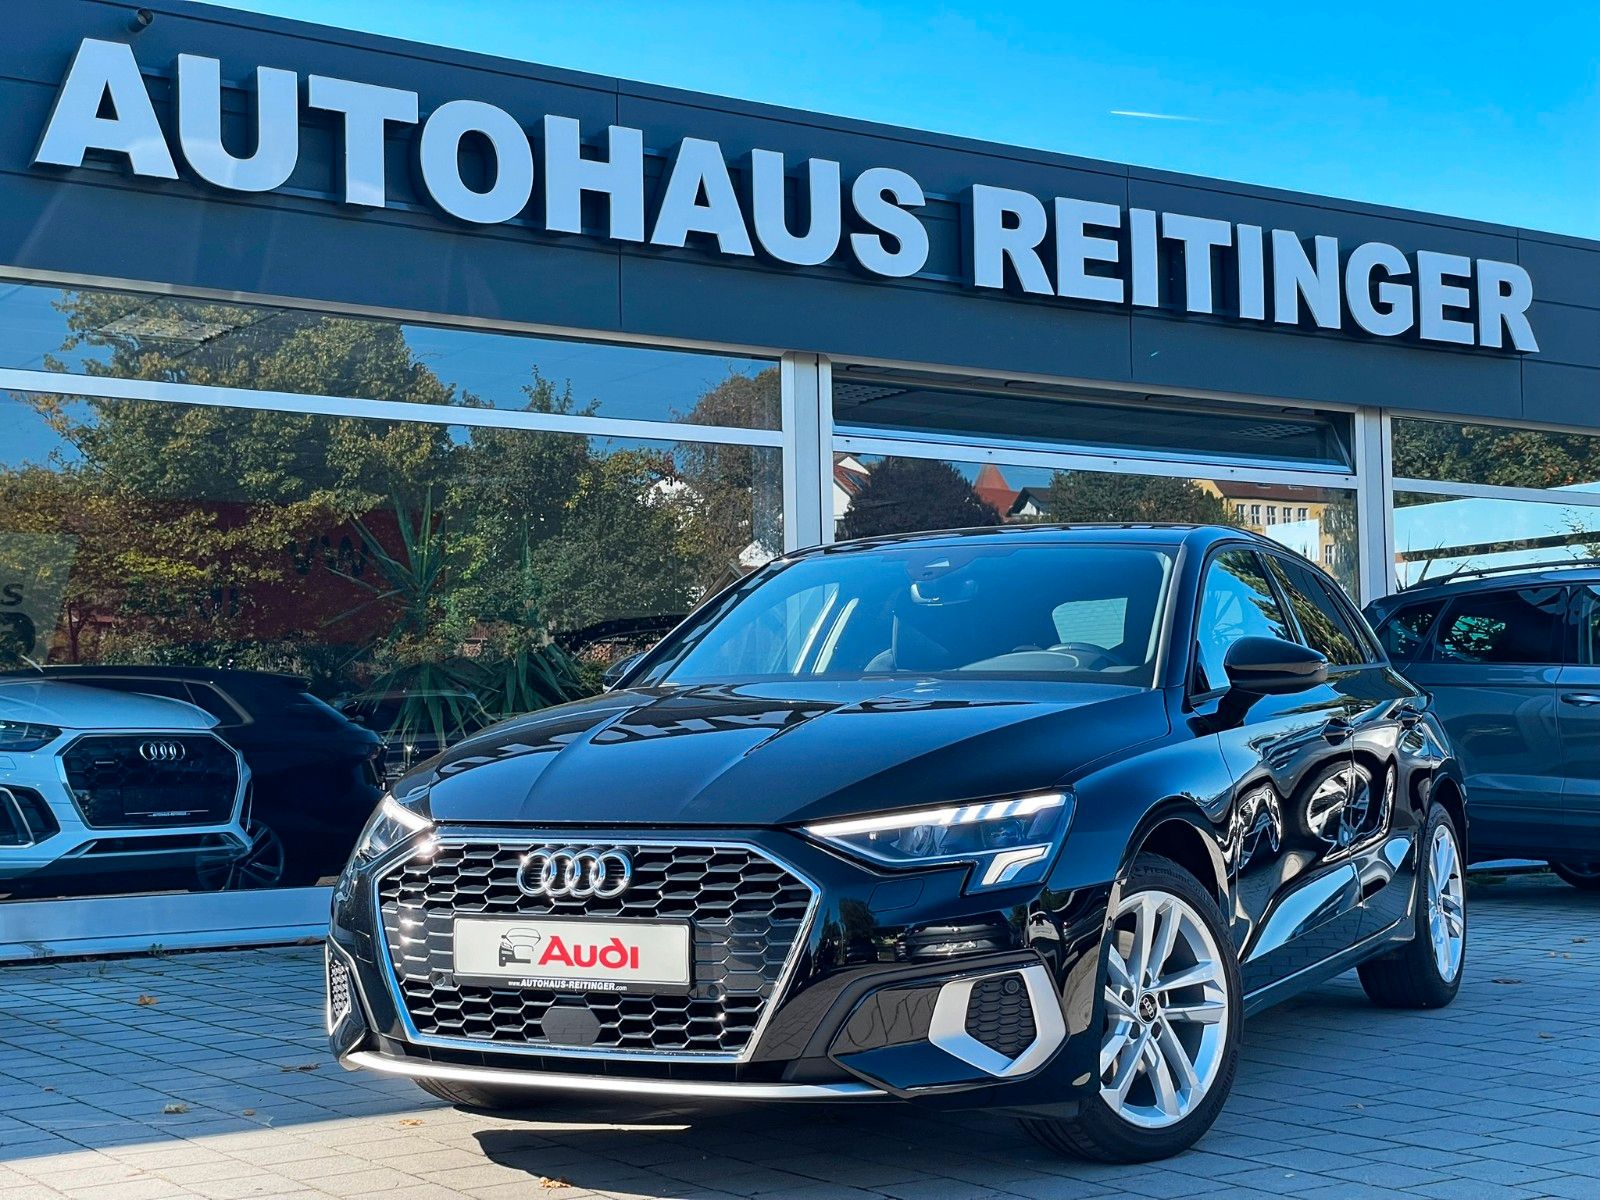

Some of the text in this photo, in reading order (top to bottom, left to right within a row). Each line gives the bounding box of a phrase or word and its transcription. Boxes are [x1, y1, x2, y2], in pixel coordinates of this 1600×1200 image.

[33, 37, 1540, 354] AUTOHAUS REITINGER
[538, 935, 639, 969] Audi
[508, 978, 628, 992] www.AUTOHAUS-REITINGER.com
